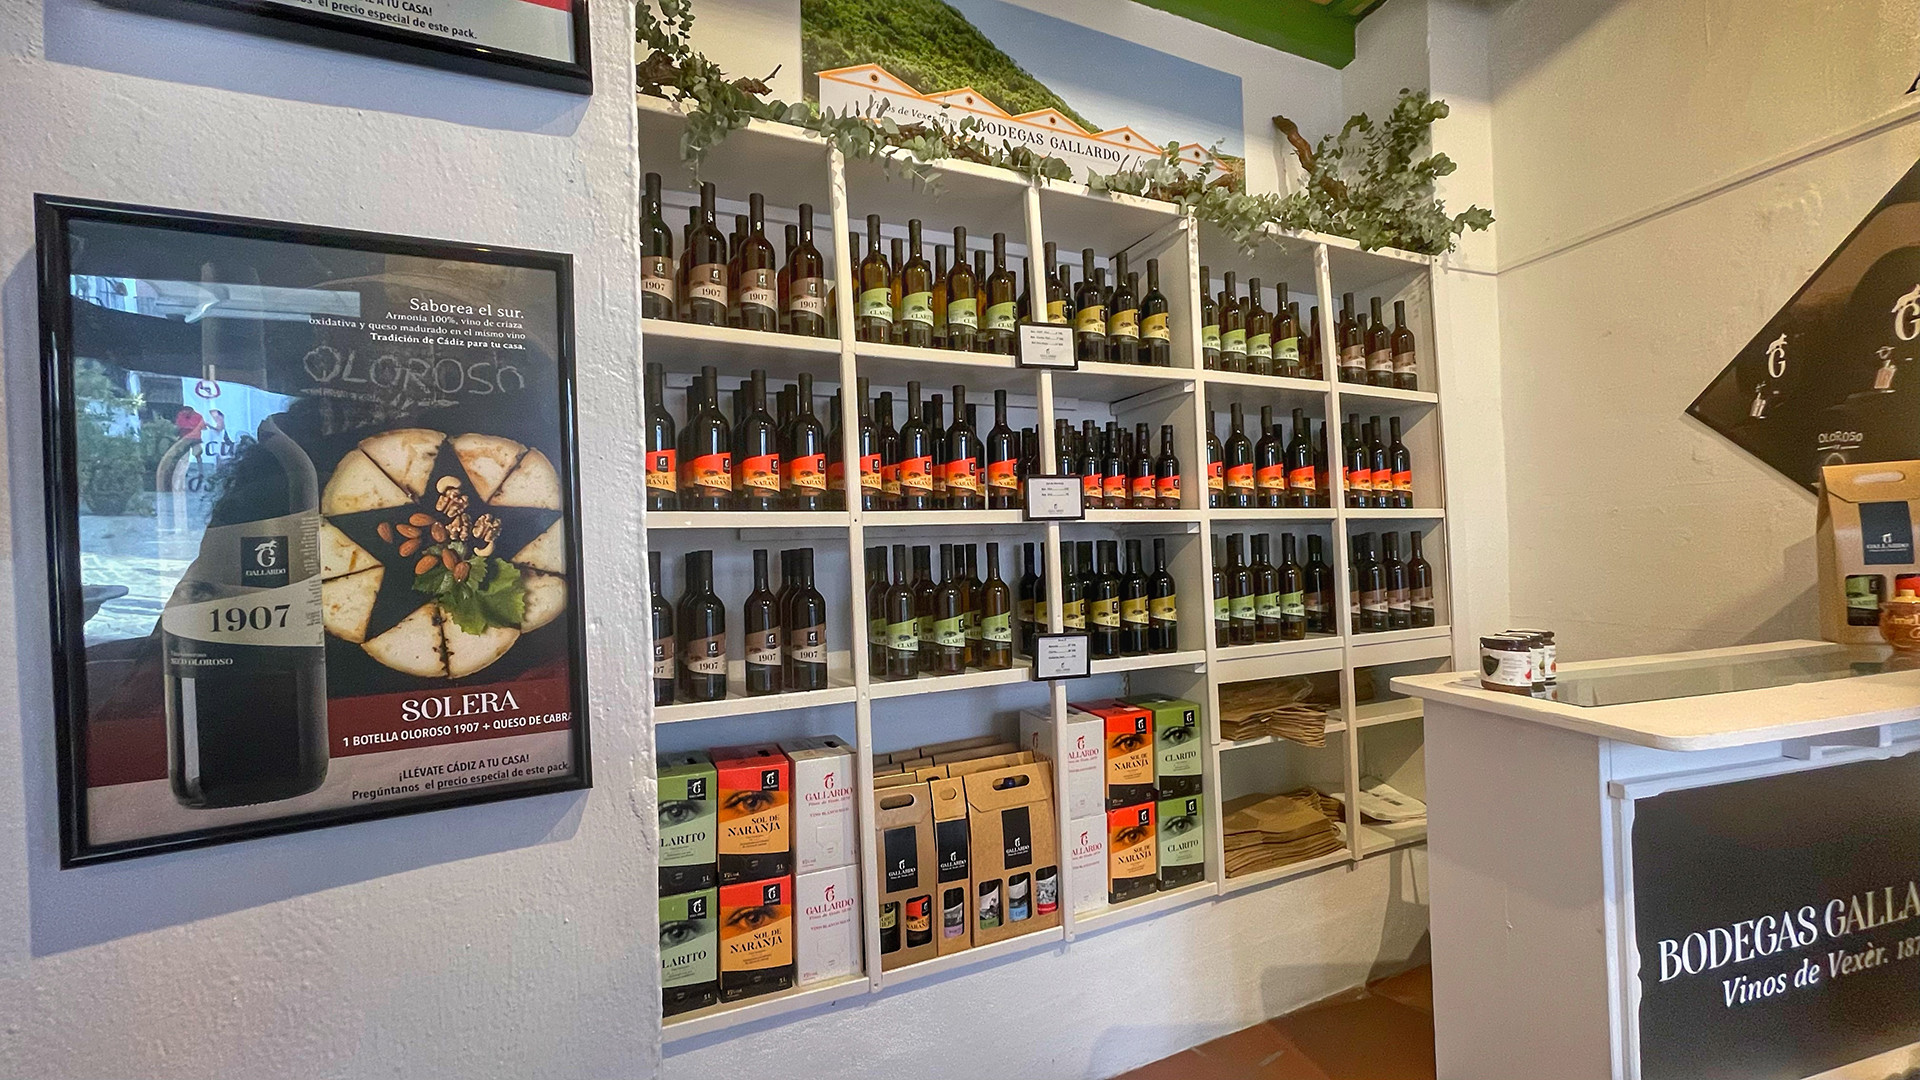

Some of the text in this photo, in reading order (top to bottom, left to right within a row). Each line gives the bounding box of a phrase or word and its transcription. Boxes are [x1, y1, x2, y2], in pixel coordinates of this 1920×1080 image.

[401, 1, 433, 16] CASA!
[332, 2, 365, 15] precio
[368, 8, 410, 25] especial
[413, 17, 425, 28] de
[428, 22, 449, 33] este
[452, 26, 478, 40] pack.
[898, 106, 909, 115] de
[980, 119, 1120, 162] BODEGAS GALLARDO
[645, 281, 666, 291] 1907
[702, 288, 721, 297] 1907
[749, 293, 768, 302] 1907
[410, 298, 524, 319] Saborea el sur.
[800, 300, 818, 309] 1907
[385, 311, 428, 322] Armonía
[461, 317, 481, 326] vino
[483, 319, 494, 327] de
[309, 317, 526, 339] oxidativa y queso madurado en el mismo vino
[370, 332, 526, 350] Tradición de Cádiz para tu casa.
[1818, 431, 1863, 443] OLOROSO
[245, 568, 286, 576] GALLARDO
[209, 603, 291, 633] 1907
[758, 653, 777, 662] 1907
[800, 650, 818, 659] 1907
[699, 661, 719, 670] 1907
[402, 690, 520, 722] SOLERA
[342, 737, 349, 747] 1
[353, 731, 399, 746] BOTELLA
[400, 726, 451, 741] OLOROSO
[454, 722, 480, 734] 1907
[483, 723, 491, 731] +
[493, 716, 526, 730] QUESO
[529, 715, 541, 725] DE
[1165, 751, 1197, 762] CLARITO
[399, 754, 530, 781] ¡LLÉVATE CÁDIZ A TU CASA!
[1114, 760, 1149, 771] NARANJA
[352, 783, 420, 800] Pregúntanos
[425, 780, 435, 790] el
[437, 776, 468, 791] precio
[470, 770, 509, 785] especial
[511, 767, 523, 777] de
[525, 766, 545, 776] este
[805, 787, 853, 802] GALLARDO
[751, 817, 767, 825] SOL
[728, 822, 781, 837] NARANJA
[1006, 844, 1030, 854] GALLARDO
[1167, 840, 1199, 852] CLARITO
[940, 859, 967, 869] GALLARDO
[1118, 853, 1152, 864] NARANJA
[888, 867, 916, 877] GALLARDO
[806, 898, 854, 916] GALLARDO
[754, 928, 782, 940] SOL DE
[1658, 880, 1920, 983] BODEGAS GALLA
[730, 936, 783, 954] NARANJA
[1722, 973, 1787, 1008] Vinos
[1794, 958, 1821, 989] de
[1828, 942, 1889, 978] Vexèr.
